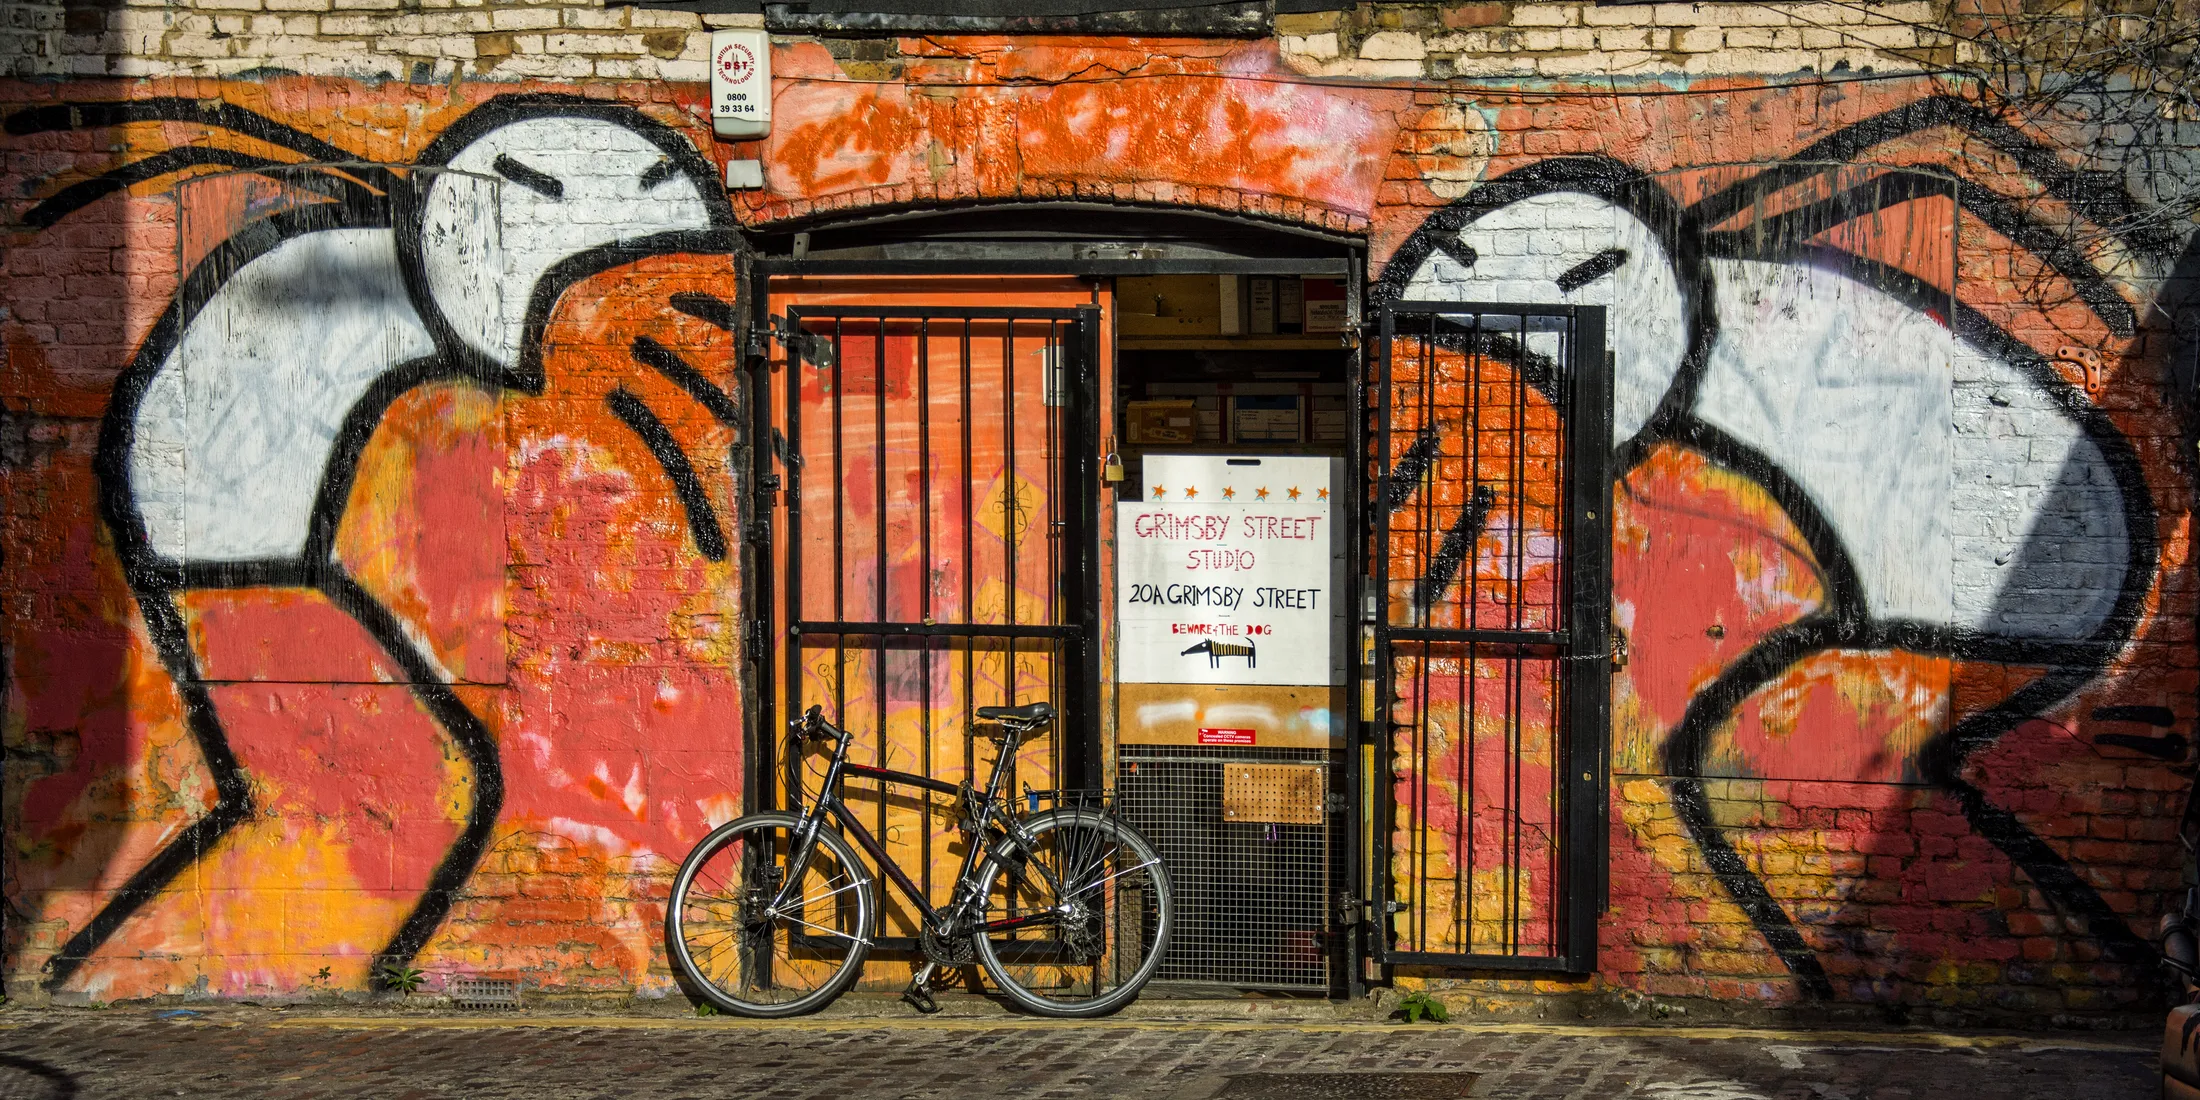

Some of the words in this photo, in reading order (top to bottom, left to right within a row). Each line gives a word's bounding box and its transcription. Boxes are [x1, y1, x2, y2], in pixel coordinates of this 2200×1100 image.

[717, 44, 733, 65] BRITISH
[734, 43, 755, 65] SECURITY
[717, 67, 755, 85] TECHNOLOGIES
[726, 93, 747, 101] 0800
[720, 105, 731, 113] 39
[732, 105, 743, 113] 33
[744, 105, 755, 113] 64
[1134, 513, 1230, 540] GRIMSBY
[1243, 516, 1322, 540] STREET
[1186, 549, 1255, 571] STUDIO
[1129, 584, 1165, 605] 20A
[1167, 584, 1244, 611] GRIMSBY
[1253, 587, 1321, 609] STREET
[1172, 623, 1212, 635] BEWARE
[1219, 623, 1239, 636] THE
[1246, 624, 1272, 636] DOG
